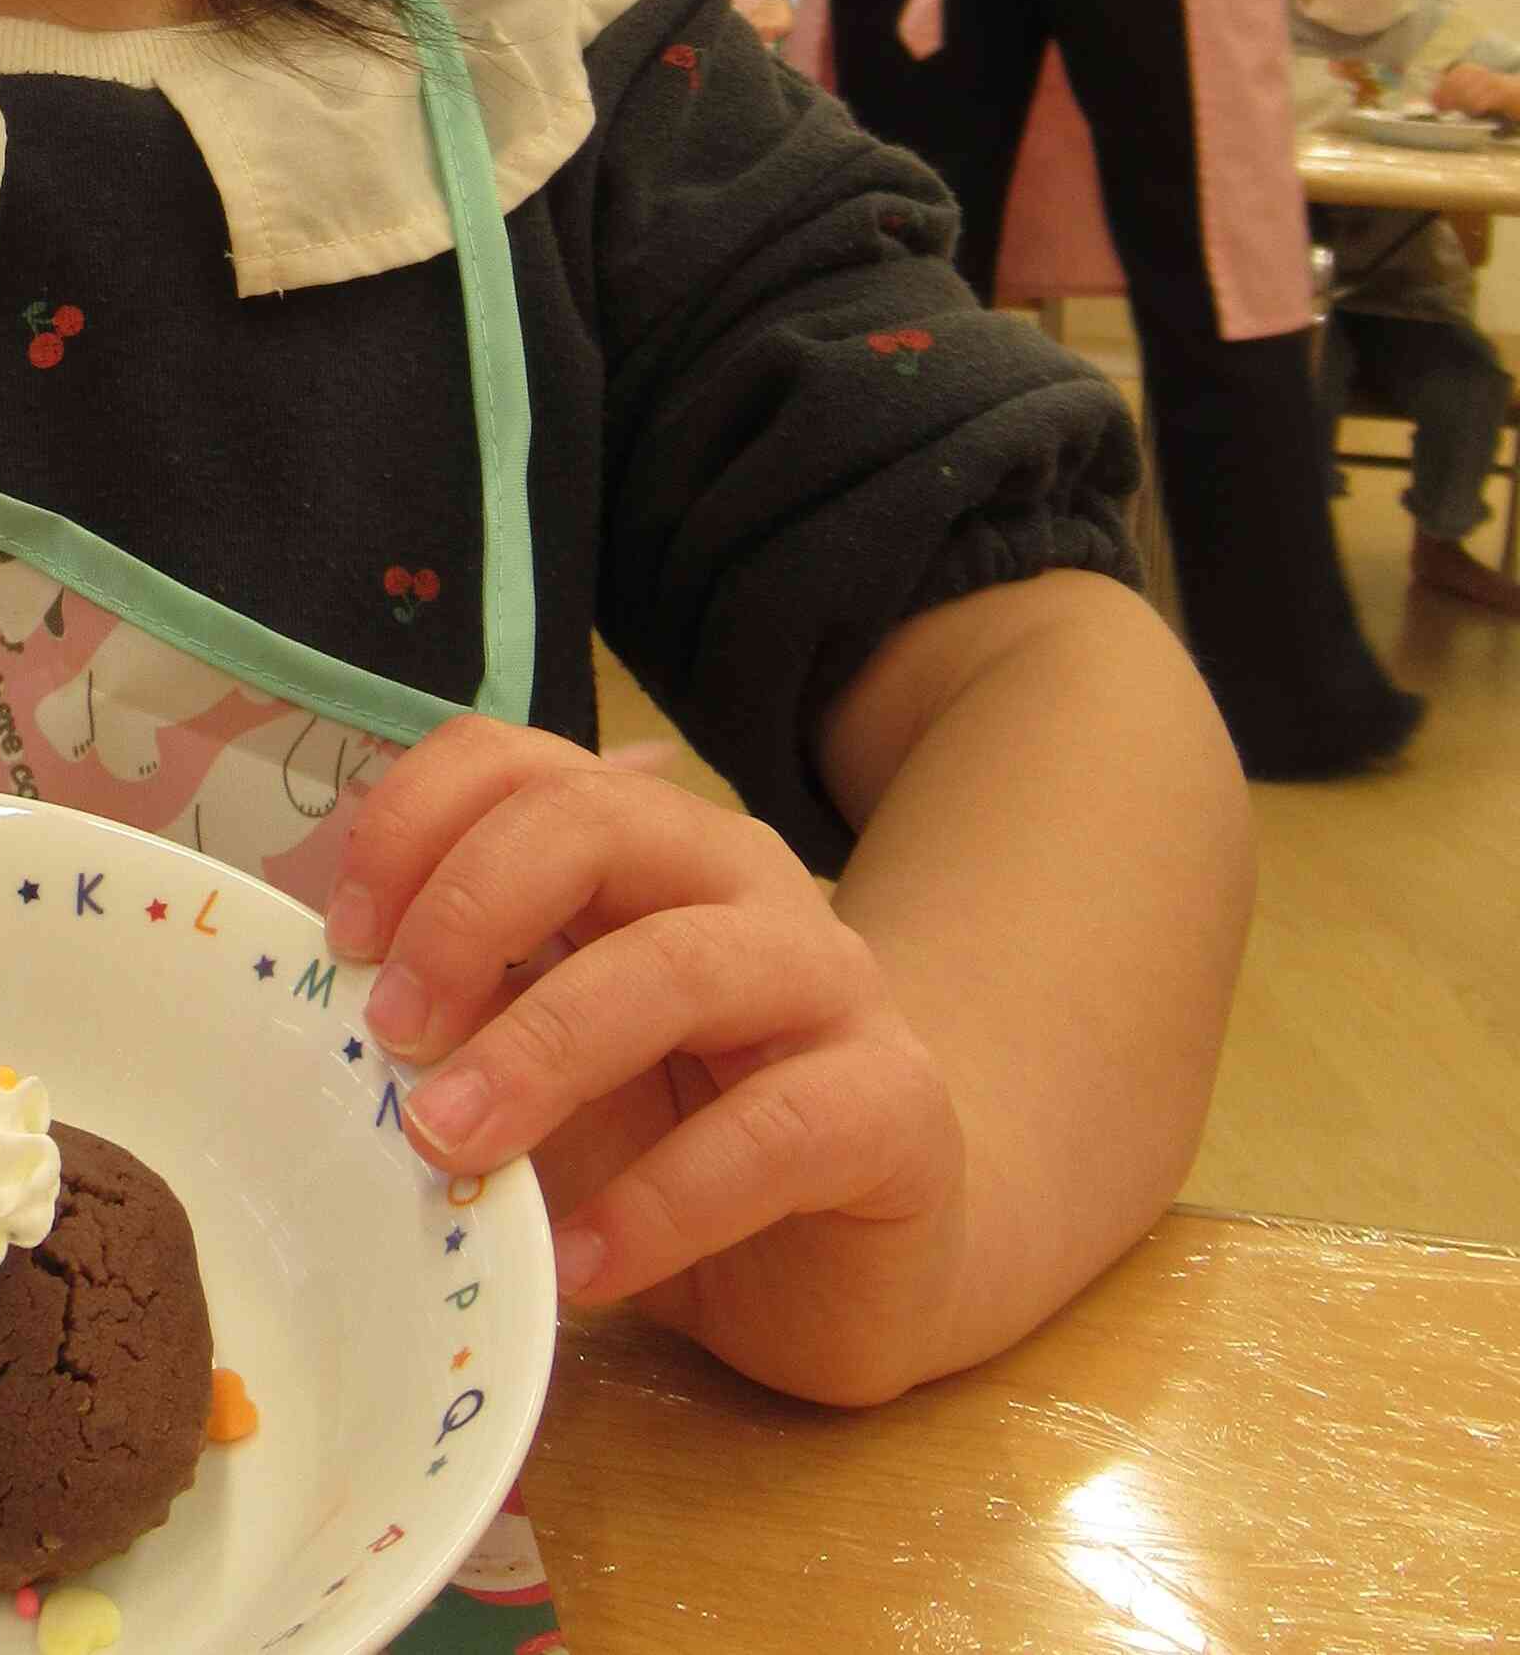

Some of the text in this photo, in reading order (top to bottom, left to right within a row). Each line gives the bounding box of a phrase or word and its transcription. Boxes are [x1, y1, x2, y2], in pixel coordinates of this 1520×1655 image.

[76, 872, 105, 917] K
[193, 888, 219, 937] L
[292, 958, 337, 1009] M
[444, 1281, 480, 1311] P
[434, 1388, 485, 1447] Q
